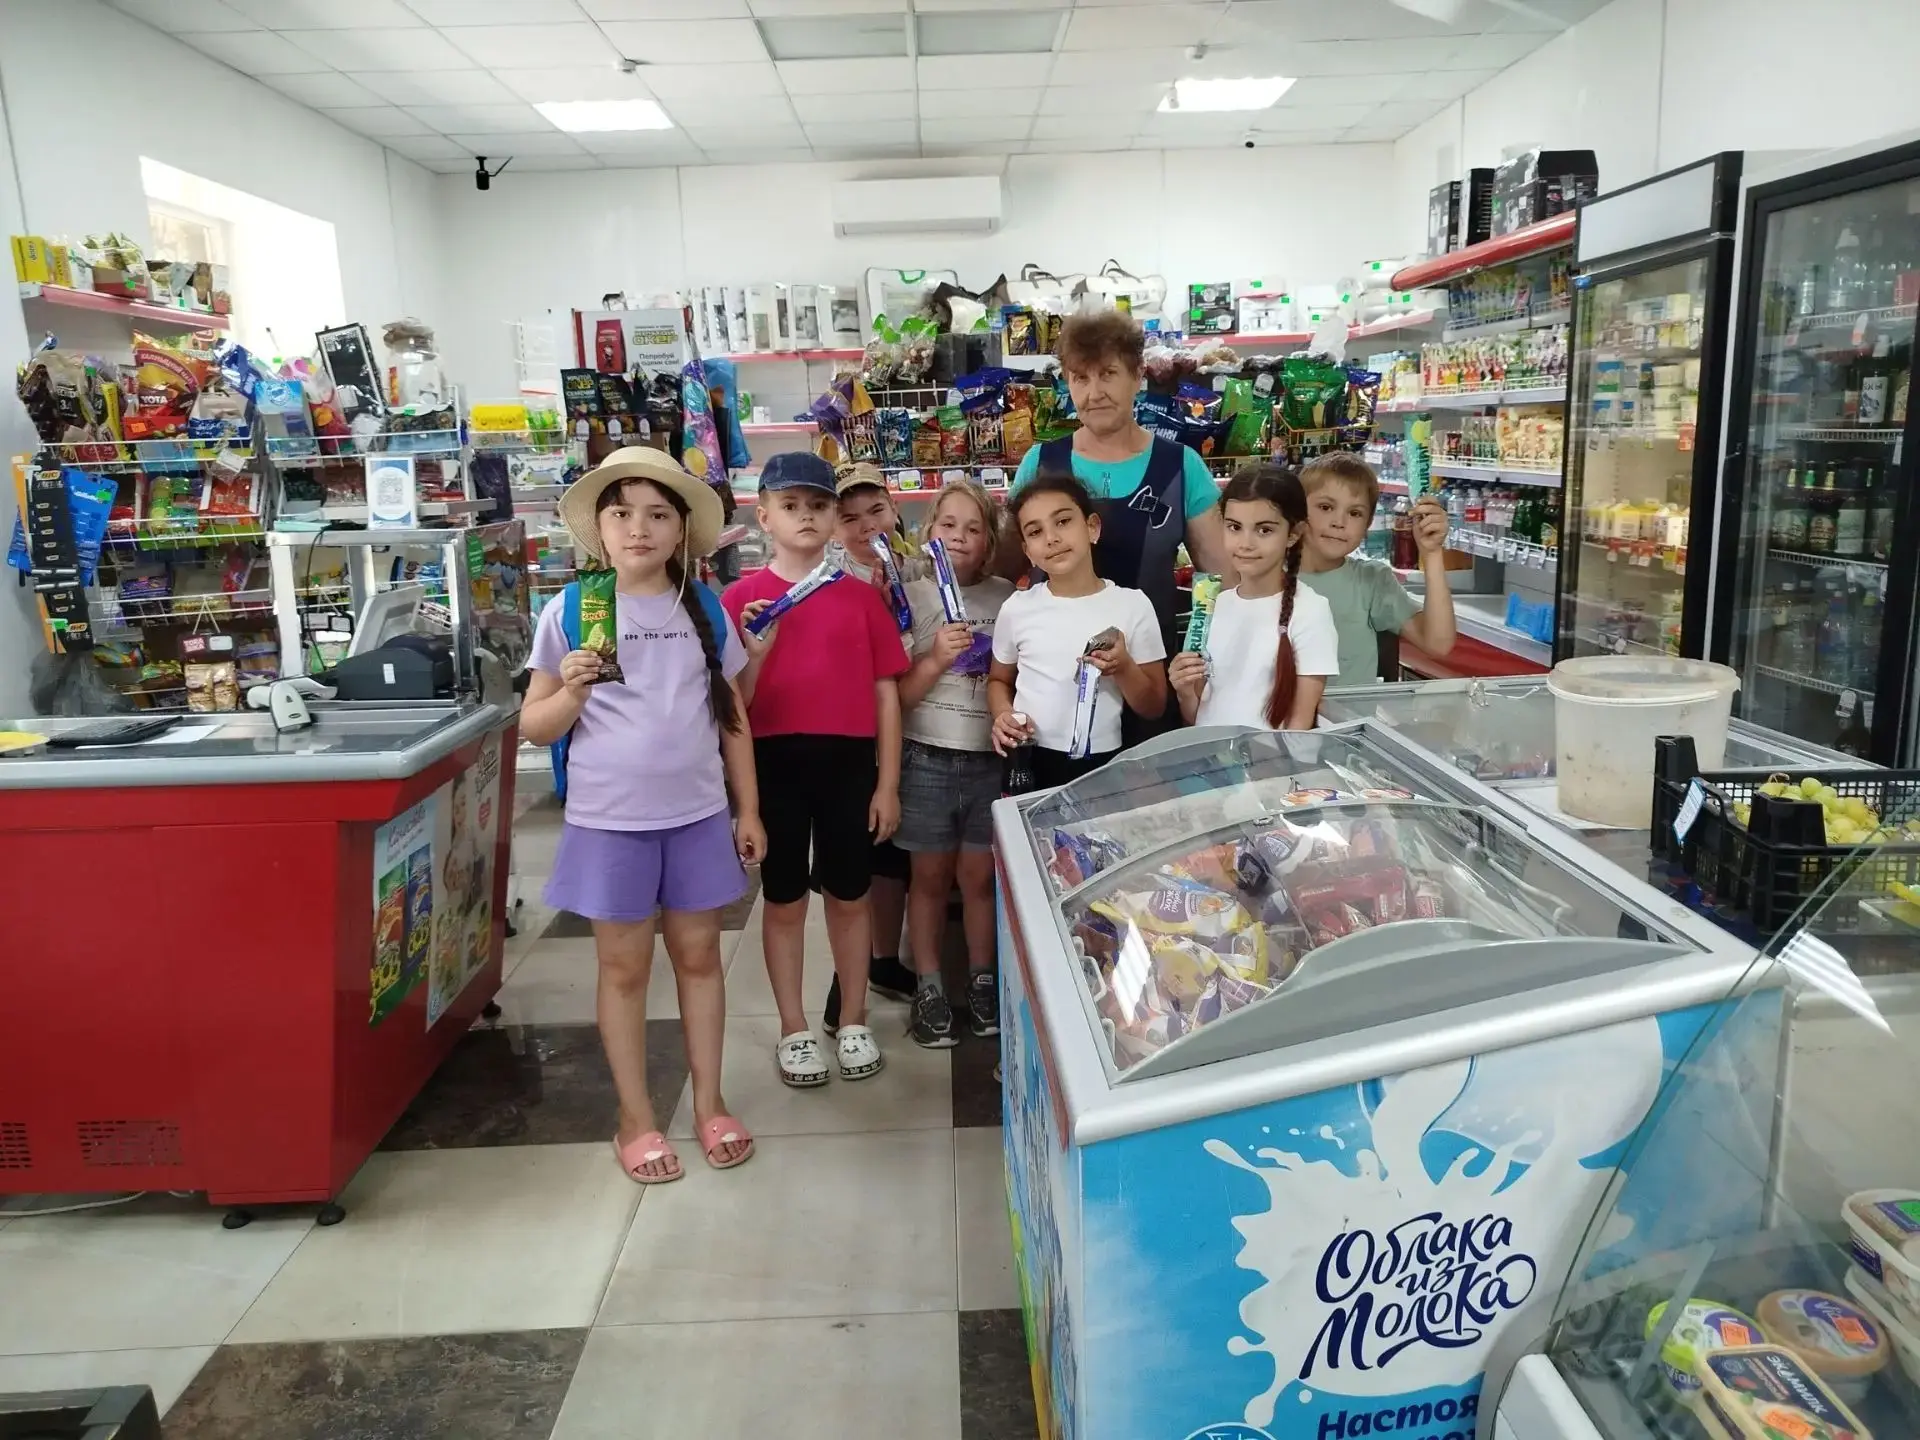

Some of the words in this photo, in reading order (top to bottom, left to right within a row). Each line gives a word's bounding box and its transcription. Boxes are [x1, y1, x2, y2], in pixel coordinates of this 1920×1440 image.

[639, 352, 675, 360] Попробуй
[644, 632, 659, 640] the
[664, 631, 689, 639] world
[1315, 1212, 1513, 1304] Облака
[1395, 1256, 1454, 1296] из
[1298, 1253, 1537, 1380] Молока
